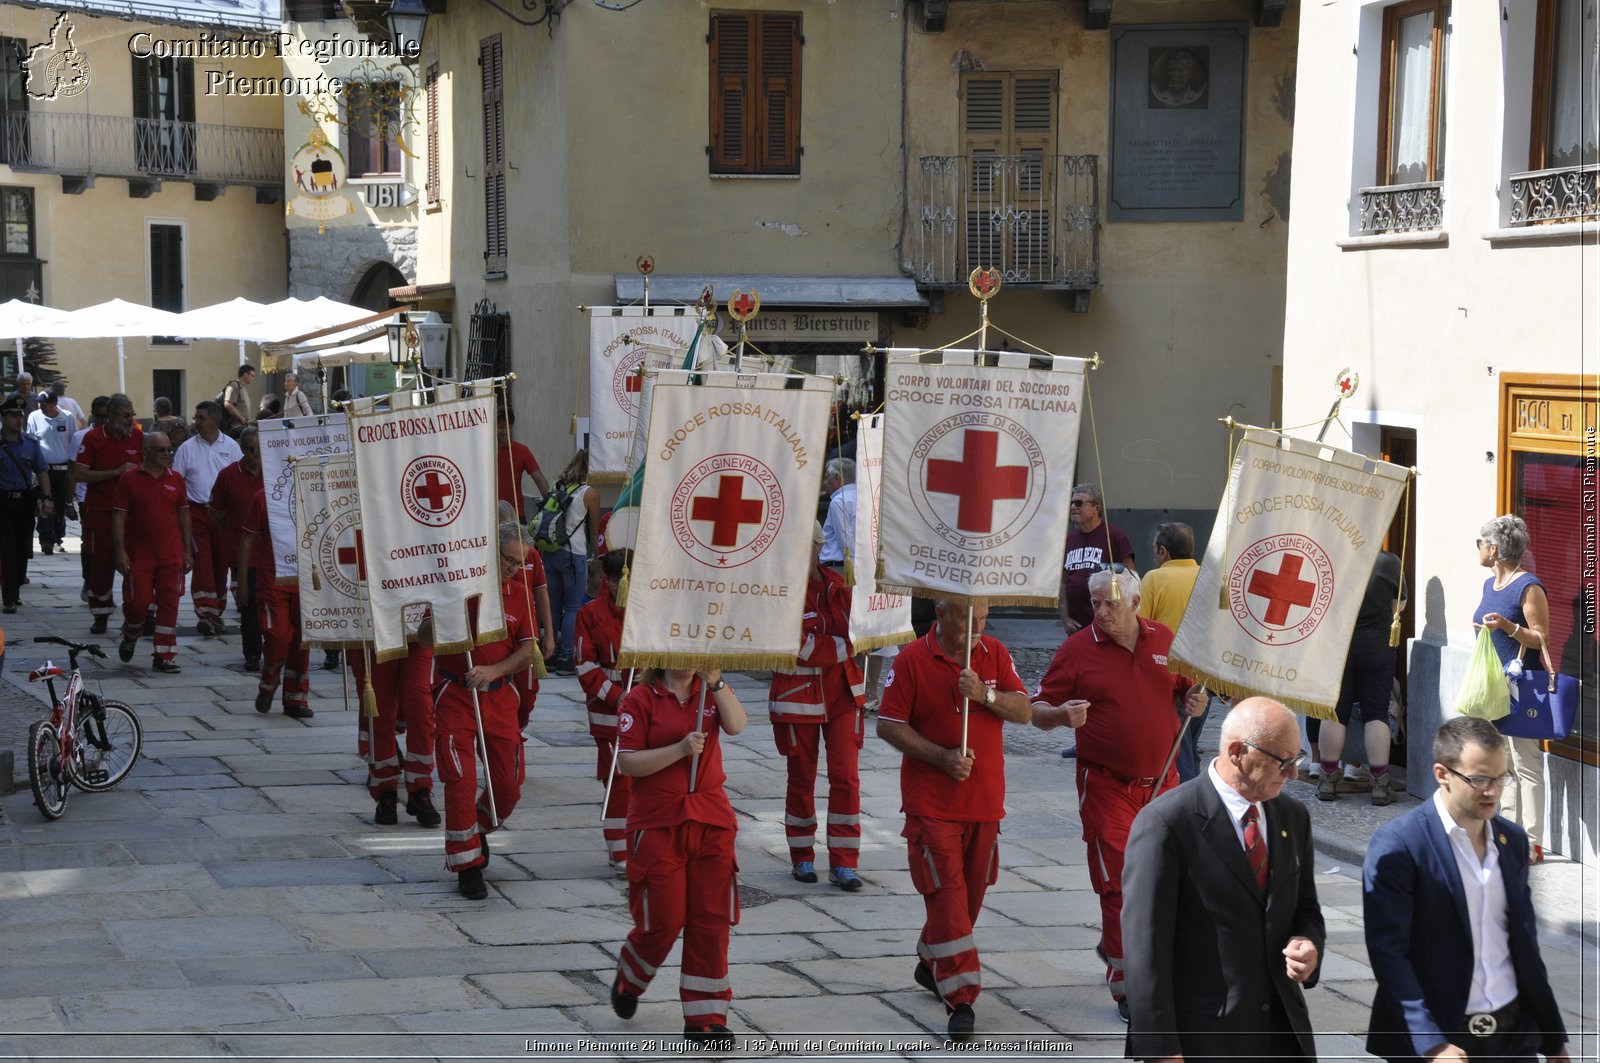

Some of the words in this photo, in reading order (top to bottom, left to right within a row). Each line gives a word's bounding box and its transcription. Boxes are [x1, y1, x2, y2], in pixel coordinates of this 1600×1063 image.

[364, 184, 400, 208] UBI
[793, 314, 871, 333] Bierstube
[629, 326, 658, 337] ROSSA
[661, 328, 689, 350] ITALIAN
[897, 374, 930, 388] CORPO
[936, 377, 991, 392] VOLONTARI
[996, 380, 1014, 393] DEL
[1019, 382, 1070, 396] SOCCORSO
[888, 389, 945, 405] CROCE
[950, 393, 1003, 409] ROSSA
[1008, 397, 1077, 414] ITALIANA
[358, 422, 398, 443] CROCE
[400, 416, 437, 437] ROSSA
[437, 406, 488, 432] ITALIANA
[1518, 399, 1550, 429] BACI
[1561, 413, 1573, 431] DI
[267, 439, 290, 448] CORPO
[293, 434, 330, 447] VOLONTARI
[605, 430, 634, 440] COMIT
[660, 412, 706, 461] CROCE
[708, 401, 761, 420] ROSSA
[763, 408, 808, 471] ITALIANA
[914, 414, 989, 460] CONVENZIONE
[1007, 423, 1043, 468] GINEVRA
[326, 469, 357, 480] VOLONTA
[408, 468, 417, 478] DI
[415, 460, 446, 471] GINEVRA
[446, 466, 454, 476] 22
[698, 463, 711, 476] DI
[711, 457, 759, 474] GINEVRA
[328, 480, 357, 491] FEMMIN
[757, 469, 772, 485] 22
[1252, 457, 1281, 474] CORPO
[1282, 464, 1325, 484] VOLONTARI
[1324, 475, 1338, 489] DEL
[1341, 480, 1385, 501] SOCCORSO
[405, 478, 430, 521] CONVENZIONE
[451, 474, 462, 503] AGOSTO
[673, 472, 700, 549] CONVENZIONE
[766, 483, 782, 531] AGOSTO
[301, 507, 332, 550] CROCE
[1236, 496, 1283, 526] CROCE
[1285, 494, 1324, 515] ROSSA
[1323, 504, 1366, 551] ITALIANA
[390, 542, 447, 560] COMITATO
[448, 535, 488, 552] LOCALE
[751, 532, 771, 554] 1864
[1264, 540, 1276, 552] DI
[1278, 537, 1318, 558] GINEVRA
[321, 534, 359, 596] CONVENZIONE
[437, 557, 449, 569] DI
[909, 544, 1013, 568] DELEGAZIONE
[1315, 555, 1328, 569] 22
[381, 572, 447, 590] SOMMARIVA
[448, 569, 468, 582] DEL
[913, 560, 1028, 586] PEVERAGNO
[1231, 545, 1264, 620] CONVENZIONE
[650, 577, 726, 594] COMITATO
[730, 581, 789, 598] LOCALE
[1313, 570, 1332, 616] AGOSTO
[311, 606, 366, 617] COMITATO
[707, 602, 724, 616] DI
[867, 592, 904, 613] MANTA
[305, 619, 348, 630] BORGO
[1298, 616, 1317, 636] 1864
[1221, 650, 1297, 682] CENTALLO
